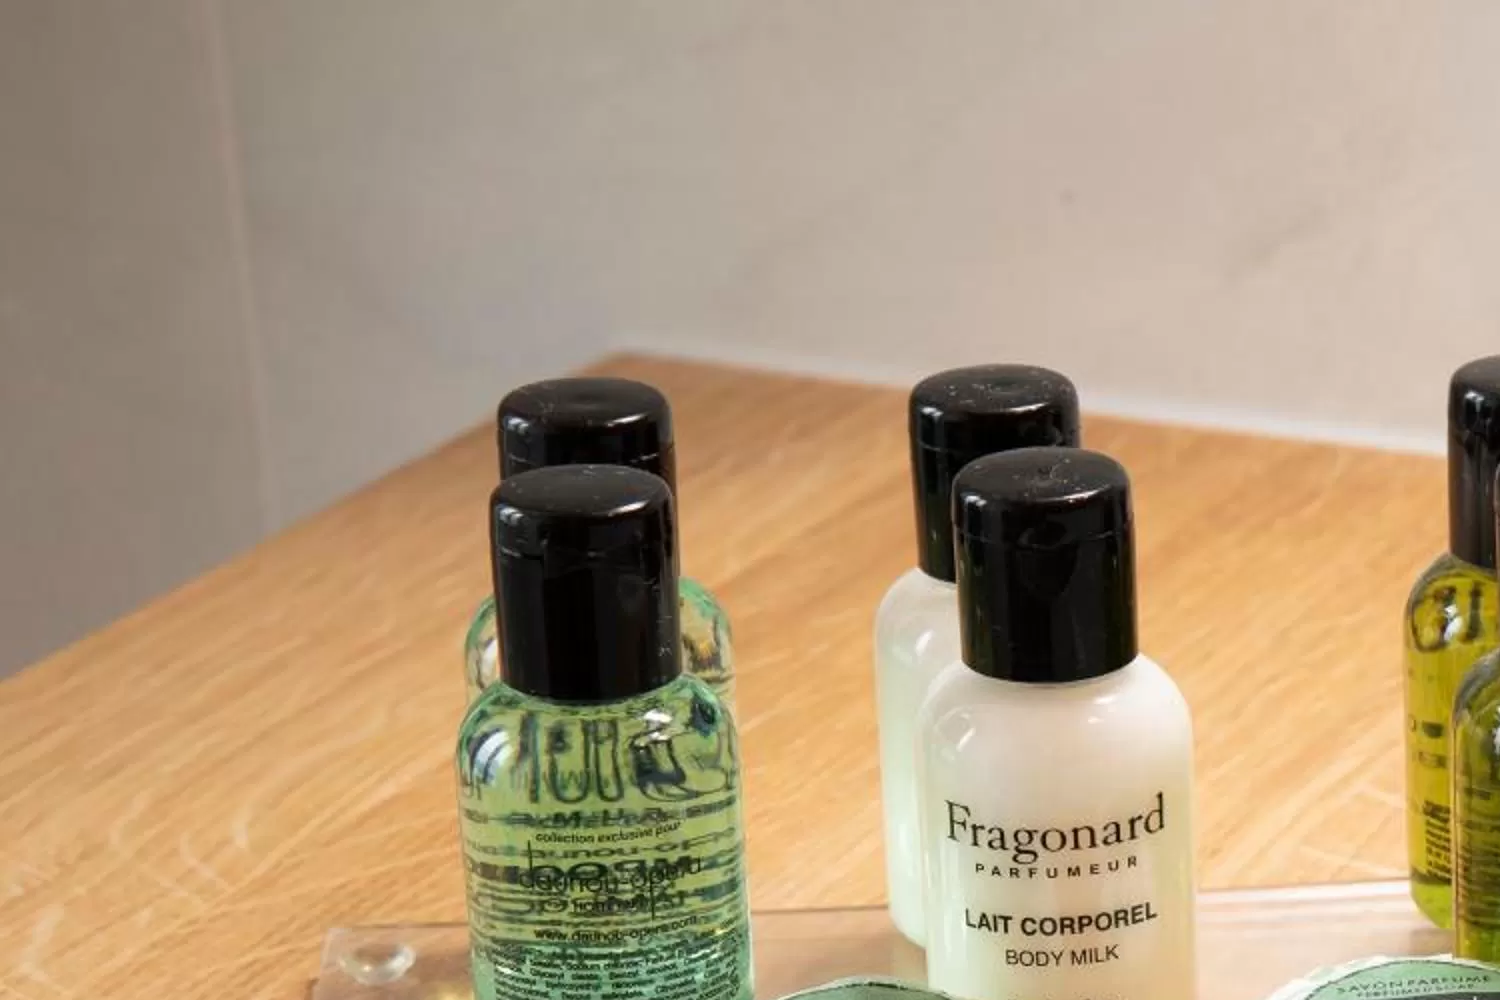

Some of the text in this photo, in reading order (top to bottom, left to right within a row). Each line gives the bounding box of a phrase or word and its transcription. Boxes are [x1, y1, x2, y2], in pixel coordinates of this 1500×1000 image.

[535, 821, 682, 845] collection exclusive pour
[944, 791, 1166, 865] Fragonard
[975, 856, 1138, 879] PARFUMEUR
[964, 901, 1158, 937] LAIT CORPOREL
[1005, 943, 1121, 968] BODY MILK
